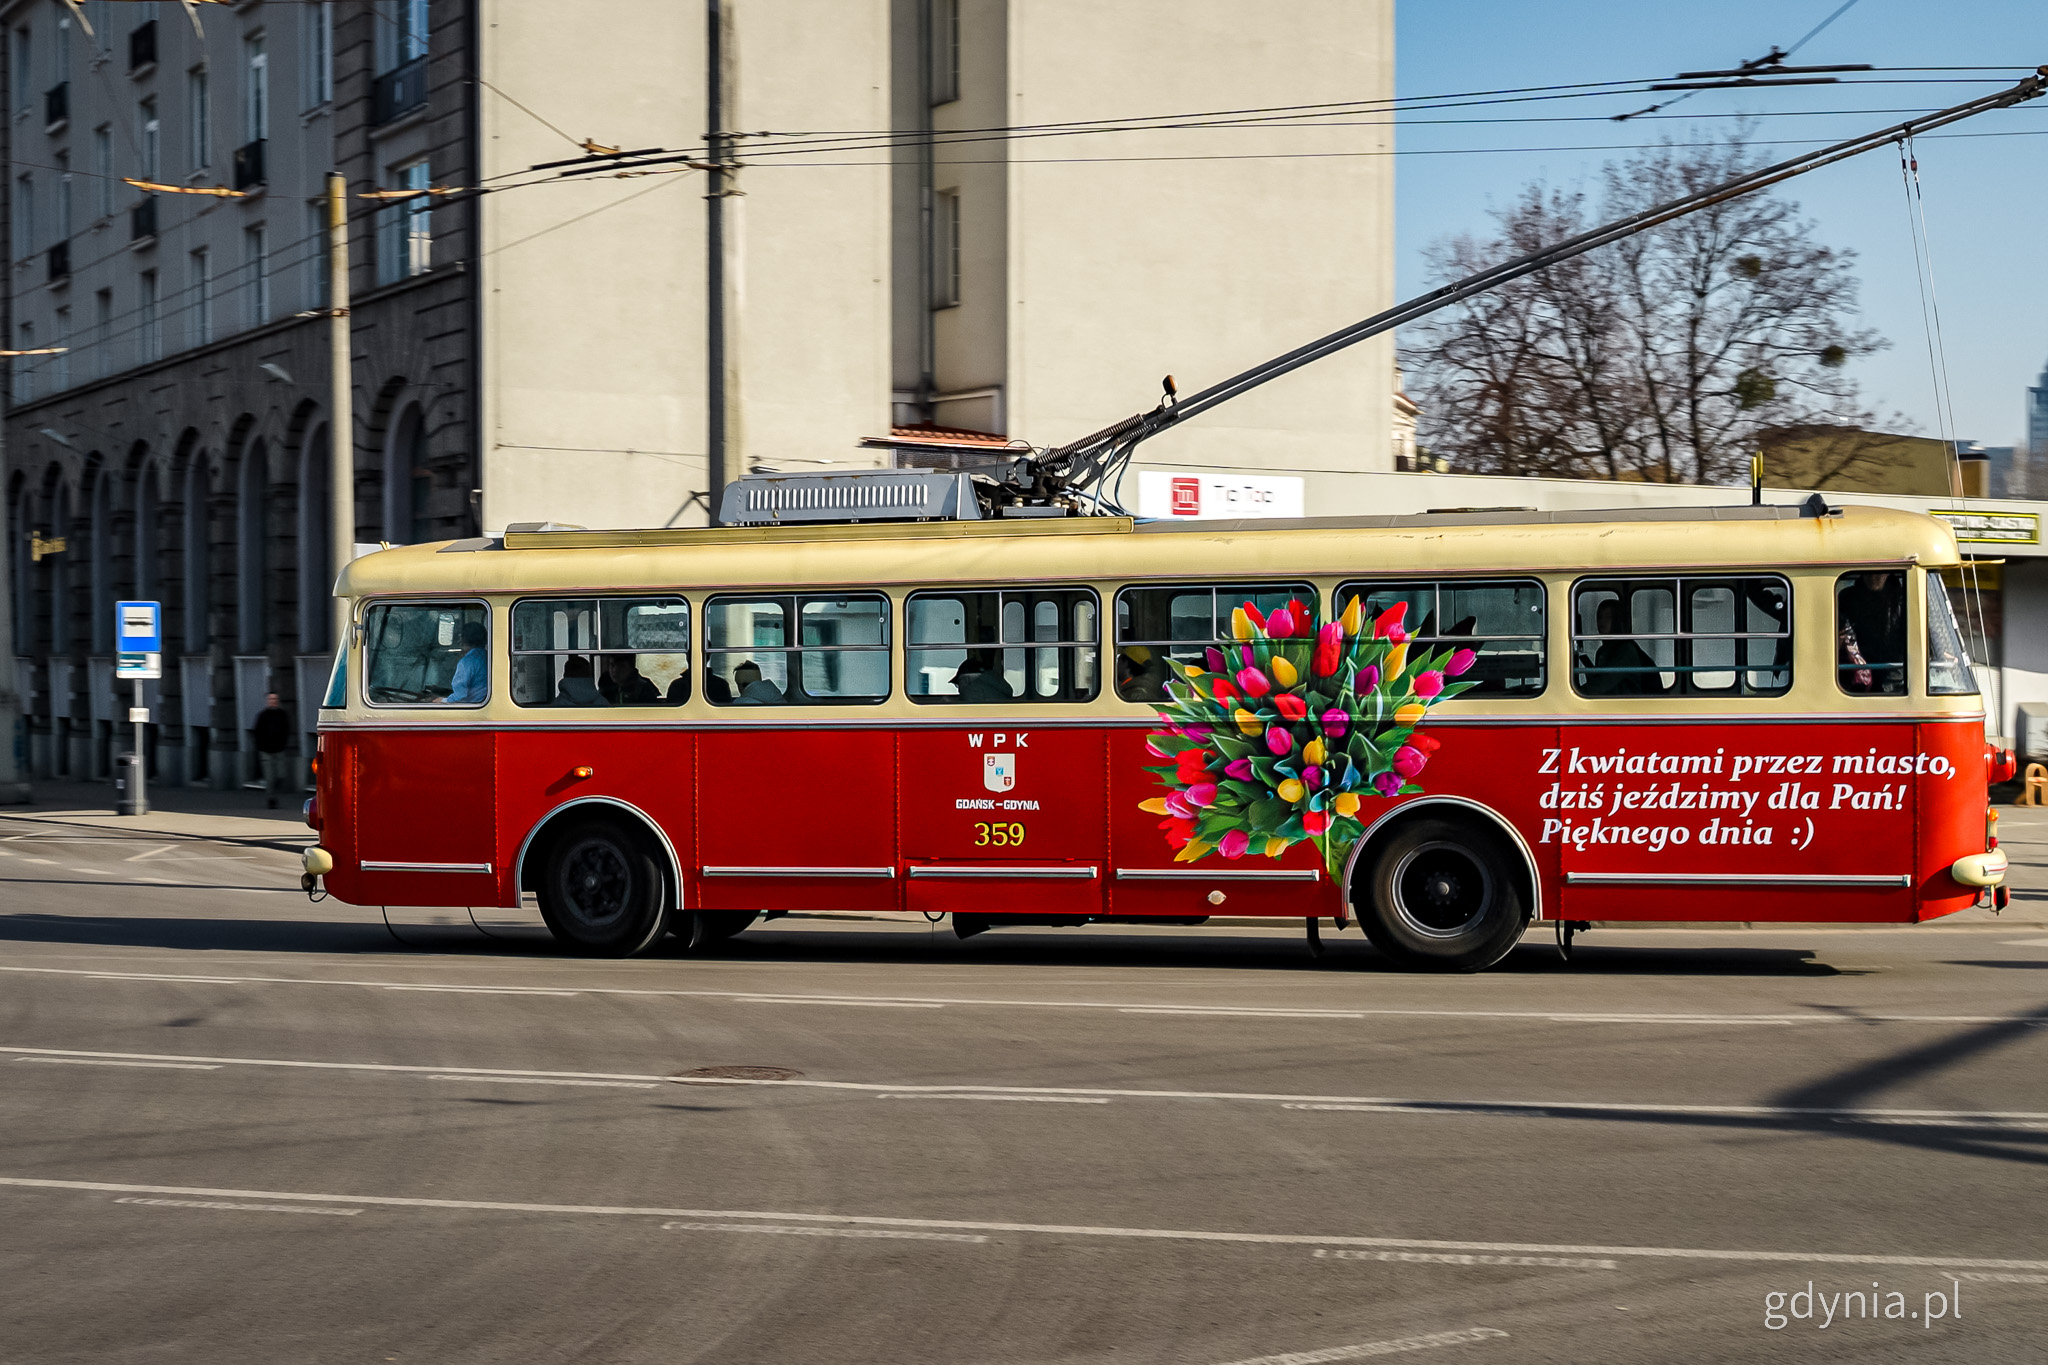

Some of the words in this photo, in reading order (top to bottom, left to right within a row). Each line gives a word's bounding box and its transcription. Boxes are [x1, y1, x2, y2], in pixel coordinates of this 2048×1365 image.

[1537, 748, 1561, 774] Z
[1567, 746, 1725, 774] kwiatami
[1728, 755, 1824, 782] przez
[1832, 747, 1956, 781] miasto,
[1539, 782, 1604, 809] dziś
[1607, 782, 1760, 818] jeździmy
[1767, 781, 1821, 810] dla
[1828, 783, 1907, 811] Pań!
[974, 822, 1025, 847] 359
[1538, 816, 1690, 852] Pięknego
[1698, 817, 1773, 845] dnia
